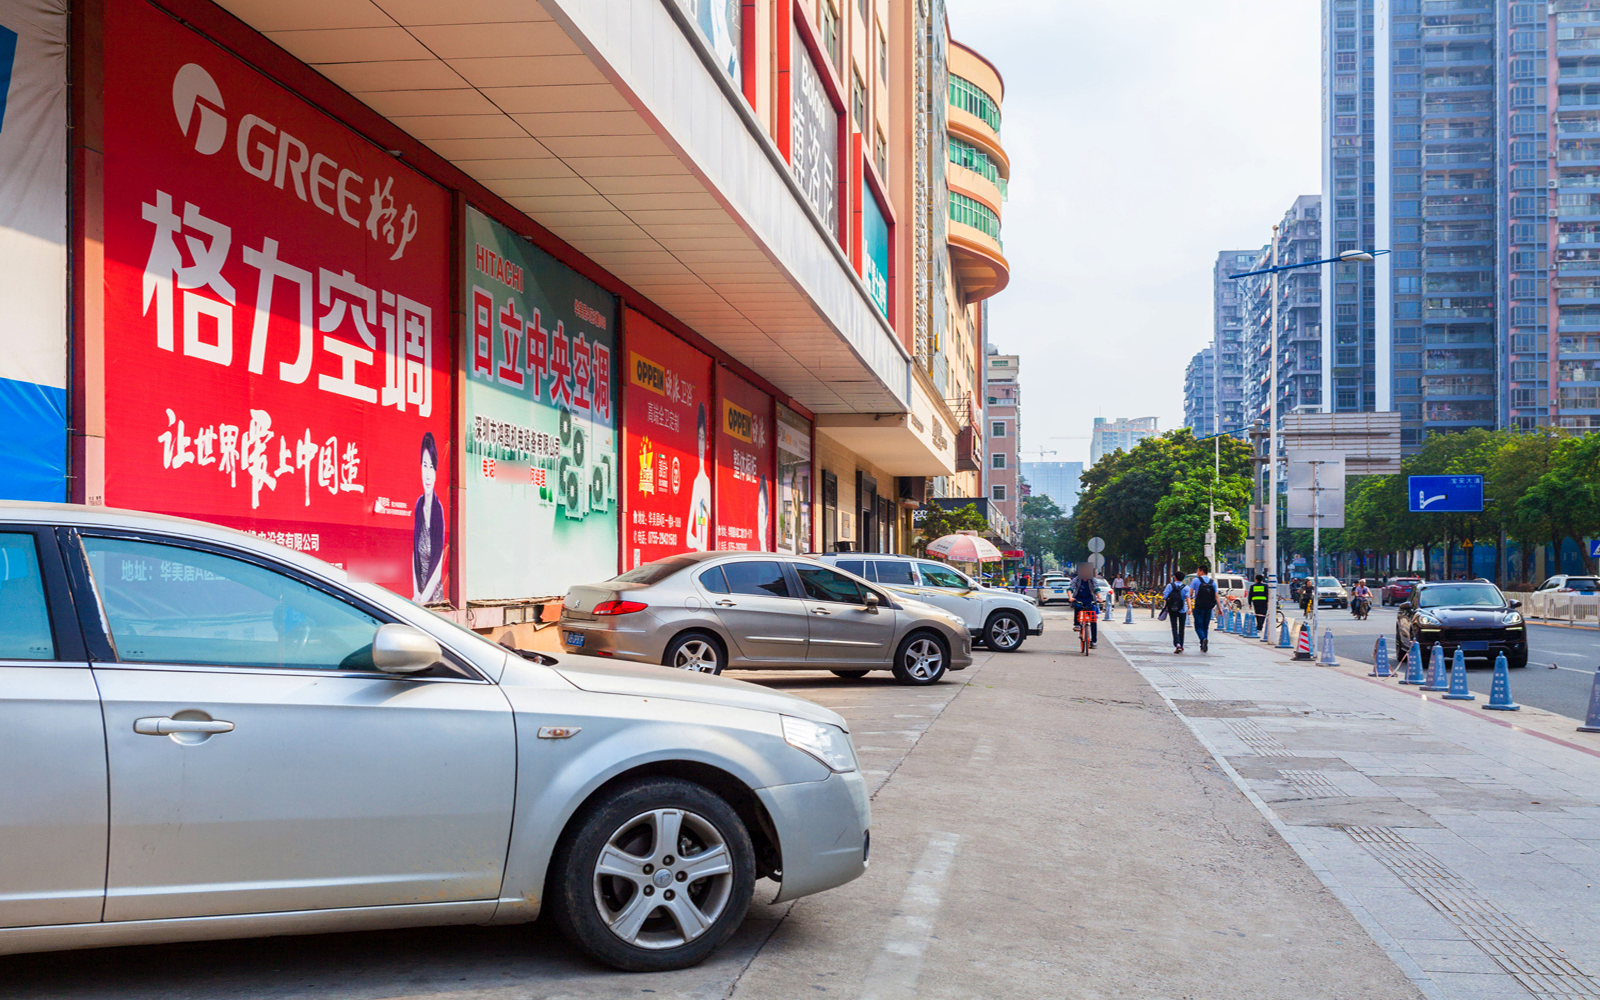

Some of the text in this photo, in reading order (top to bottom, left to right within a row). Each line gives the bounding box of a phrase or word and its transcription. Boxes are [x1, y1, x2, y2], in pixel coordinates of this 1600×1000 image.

[237, 114, 419, 261] GREE 格力
[141, 189, 432, 418] 格力空调
[475, 242, 524, 294] HITACHI
[473, 284, 611, 421] 日立中央空调
[637, 359, 664, 391] OPPEIN
[728, 407, 751, 439] OPPEIN
